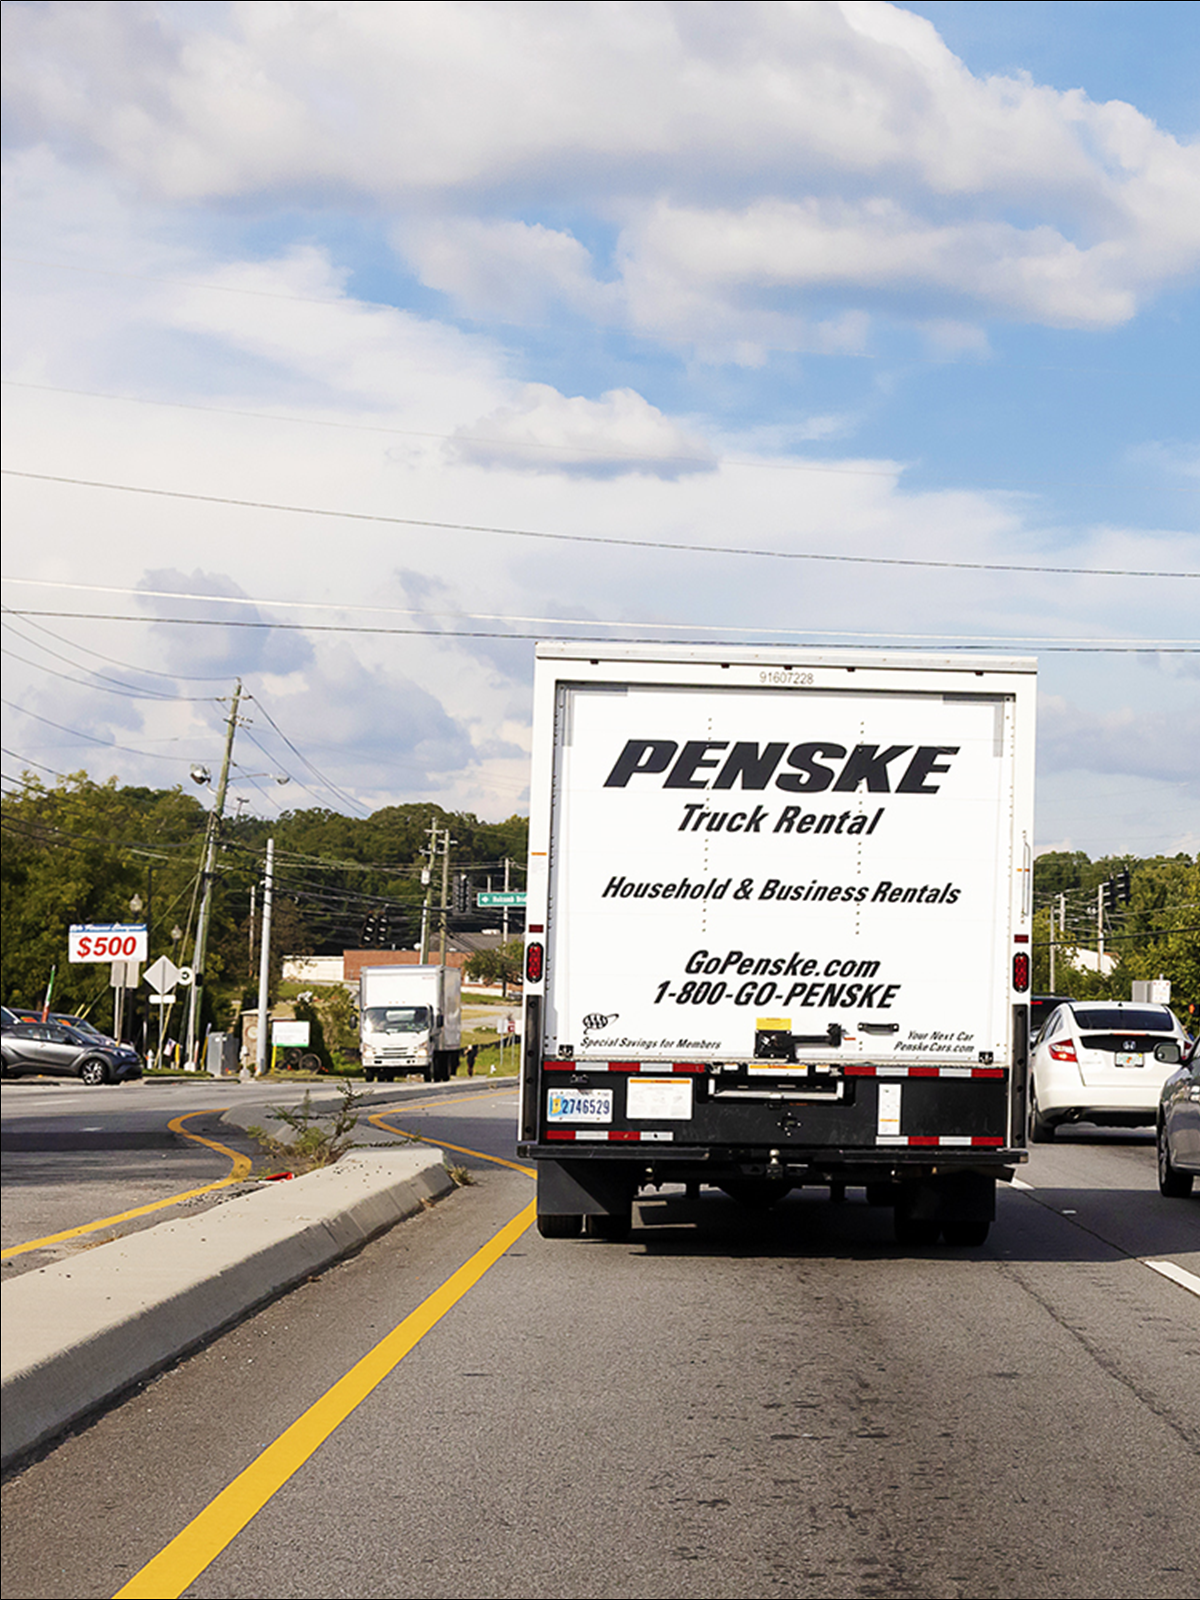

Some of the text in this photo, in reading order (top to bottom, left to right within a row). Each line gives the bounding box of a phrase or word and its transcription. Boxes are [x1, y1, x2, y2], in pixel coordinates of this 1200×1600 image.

[759, 671, 814, 685] 91607228
[603, 739, 961, 795] PENSKE
[677, 803, 885, 835] Truck Rental
[602, 876, 962, 904] Household & Business Rentals
[77, 936, 137, 958] $500
[685, 949, 881, 978] GoPenske.com
[653, 980, 902, 1009] 1-800-GO-PENSKE
[580, 1036, 721, 1050] Special Savings for Members
[908, 1030, 974, 1041] Your Next Car
[562, 1099, 610, 1115] 2746529
